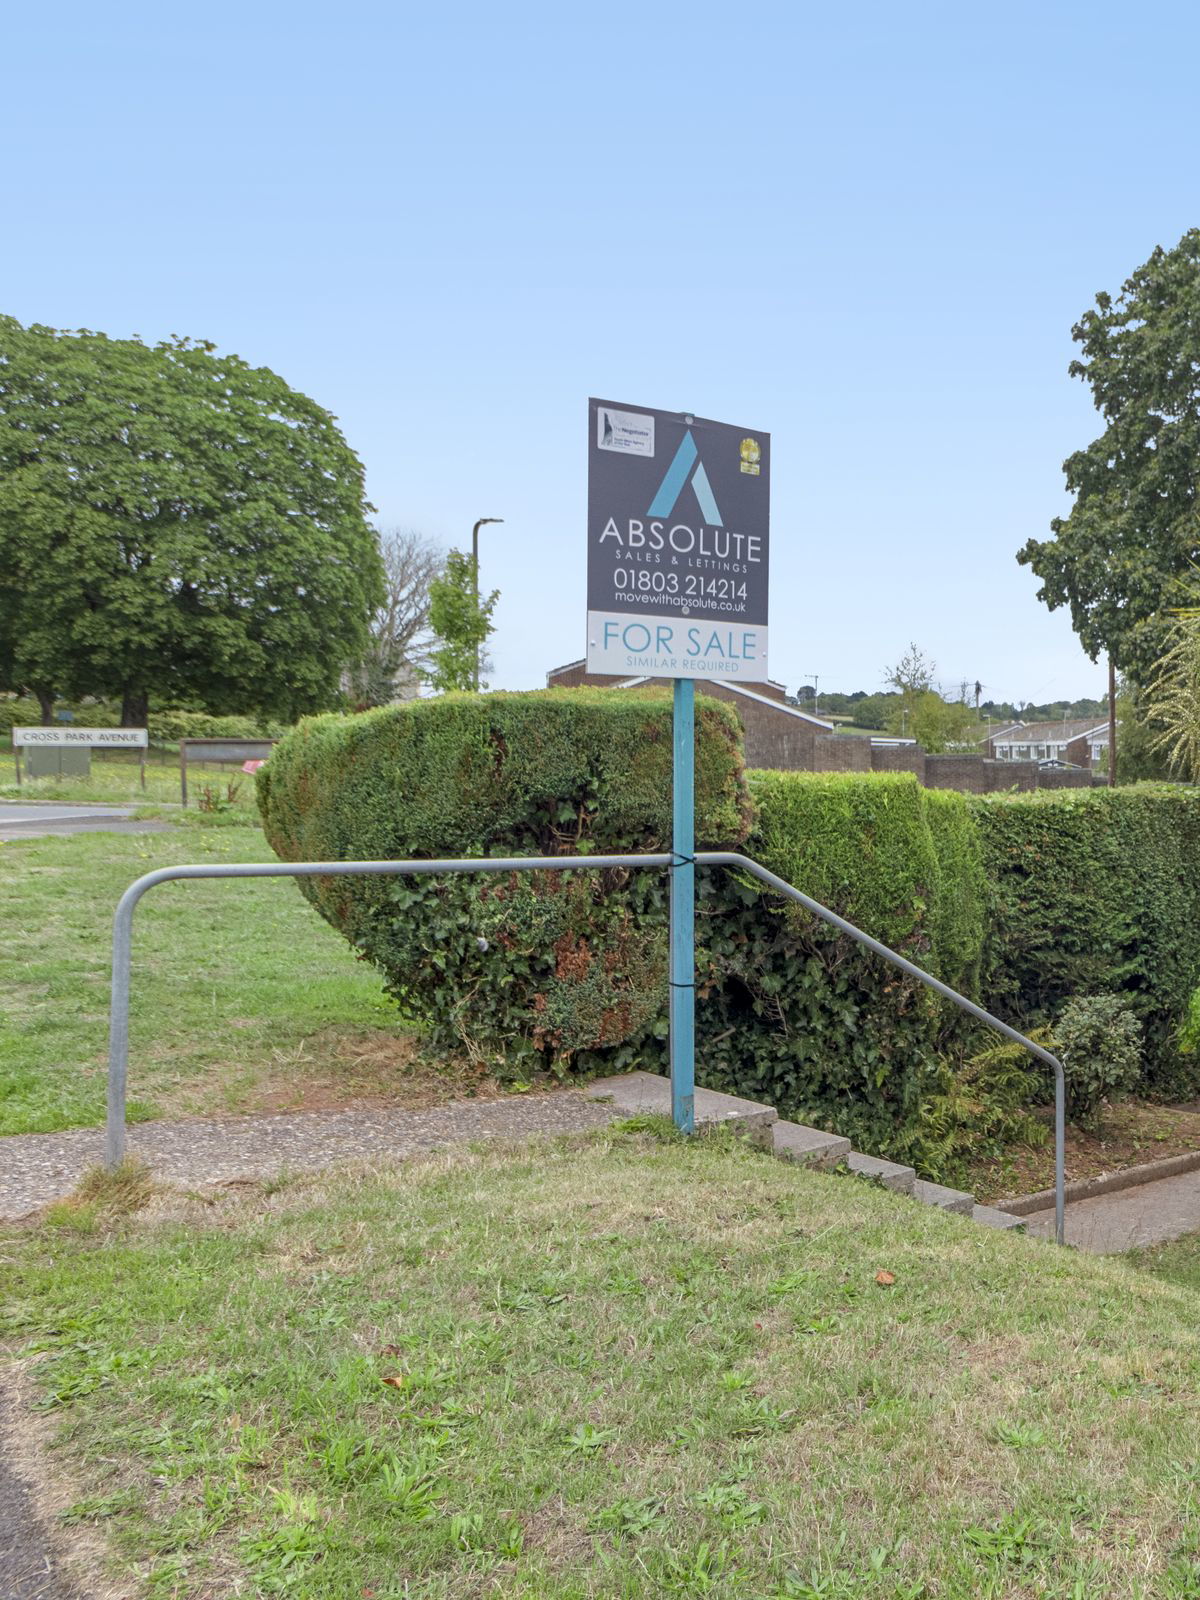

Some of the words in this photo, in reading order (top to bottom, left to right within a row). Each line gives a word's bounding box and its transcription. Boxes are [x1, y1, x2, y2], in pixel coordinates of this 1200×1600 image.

[599, 517, 761, 562] ABSOLUTE
[615, 549, 661, 563] SALES
[671, 556, 679, 565] &
[688, 557, 748, 574] LETTINGS
[614, 568, 679, 594] 01803
[685, 575, 748, 601] 214214
[615, 591, 746, 613] movewithabsolute.co.uk
[604, 622, 674, 654] FOR
[686, 628, 756, 660] SALE
[626, 656, 677, 669] SIMILAR
[682, 659, 739, 673] REQUIRED
[23, 732, 60, 741] CROSS
[65, 733, 93, 742] PARK
[99, 733, 140, 742] AVENUE
